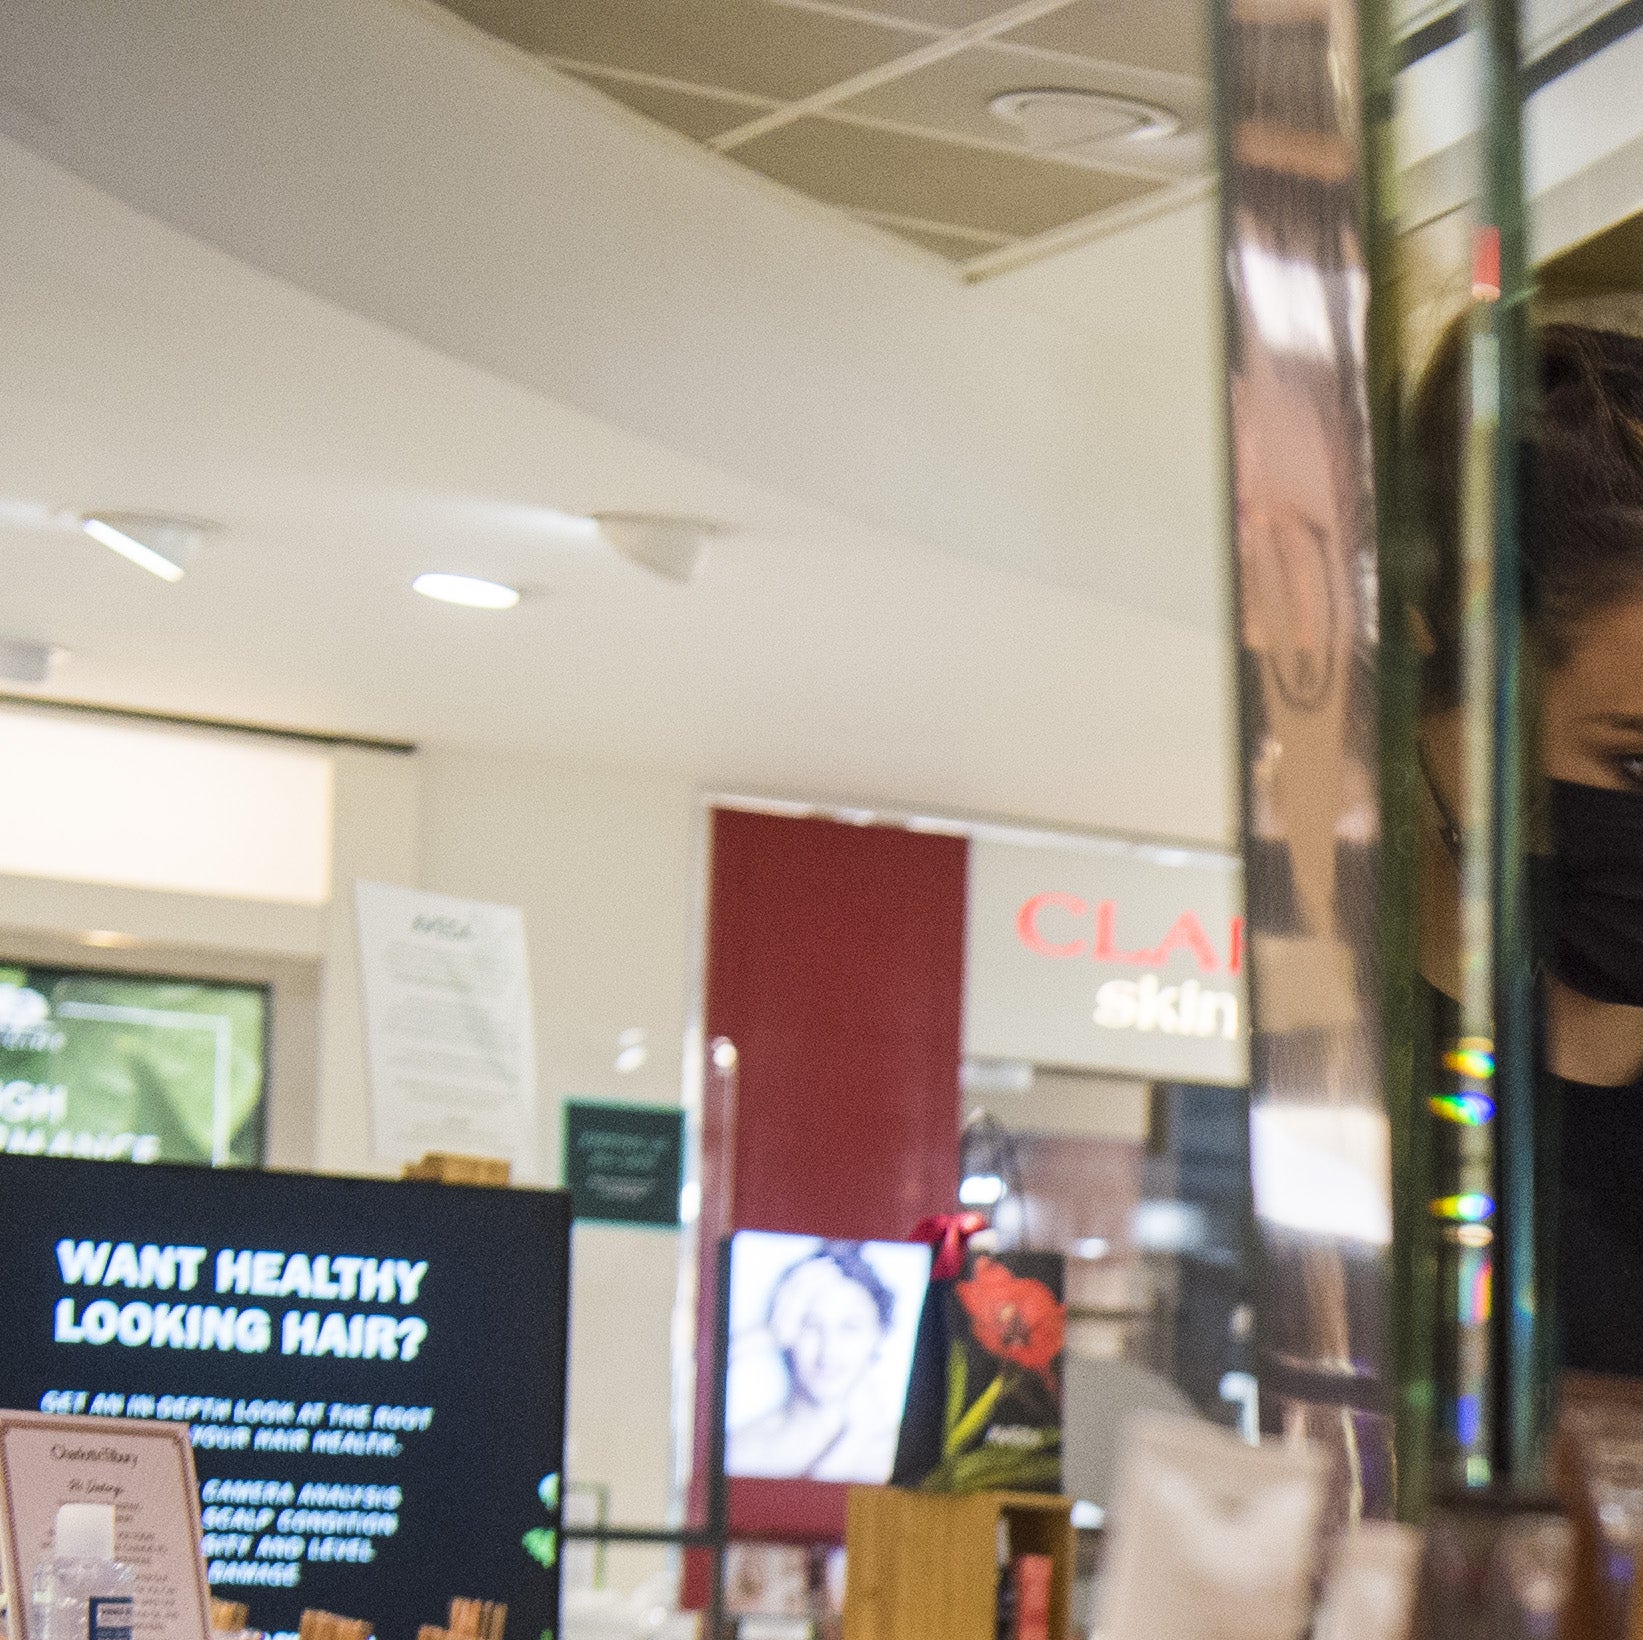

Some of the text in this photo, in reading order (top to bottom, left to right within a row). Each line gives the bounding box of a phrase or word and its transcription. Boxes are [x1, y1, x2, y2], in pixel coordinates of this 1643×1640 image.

[1093, 974, 1239, 1040] skin
[55, 1238, 429, 1304] WANT HEALTHY
[54, 1298, 429, 1361] LOOKING HAIR?
[40, 1390, 90, 1415] GET
[90, 1392, 126, 1417] AN
[232, 1399, 296, 1425] LOOK
[296, 1401, 326, 1427] AT
[327, 1402, 372, 1430] THE
[373, 1405, 435, 1432] ROOT
[189, 1424, 251, 1450] YOUR
[254, 1427, 310, 1452] HAIR
[202, 1478, 403, 1511] CAMERA ANALYSIS
[202, 1505, 400, 1537] SCALP CONDITION
[255, 1534, 306, 1560] AND
[207, 1558, 301, 1588] DAMAGE
